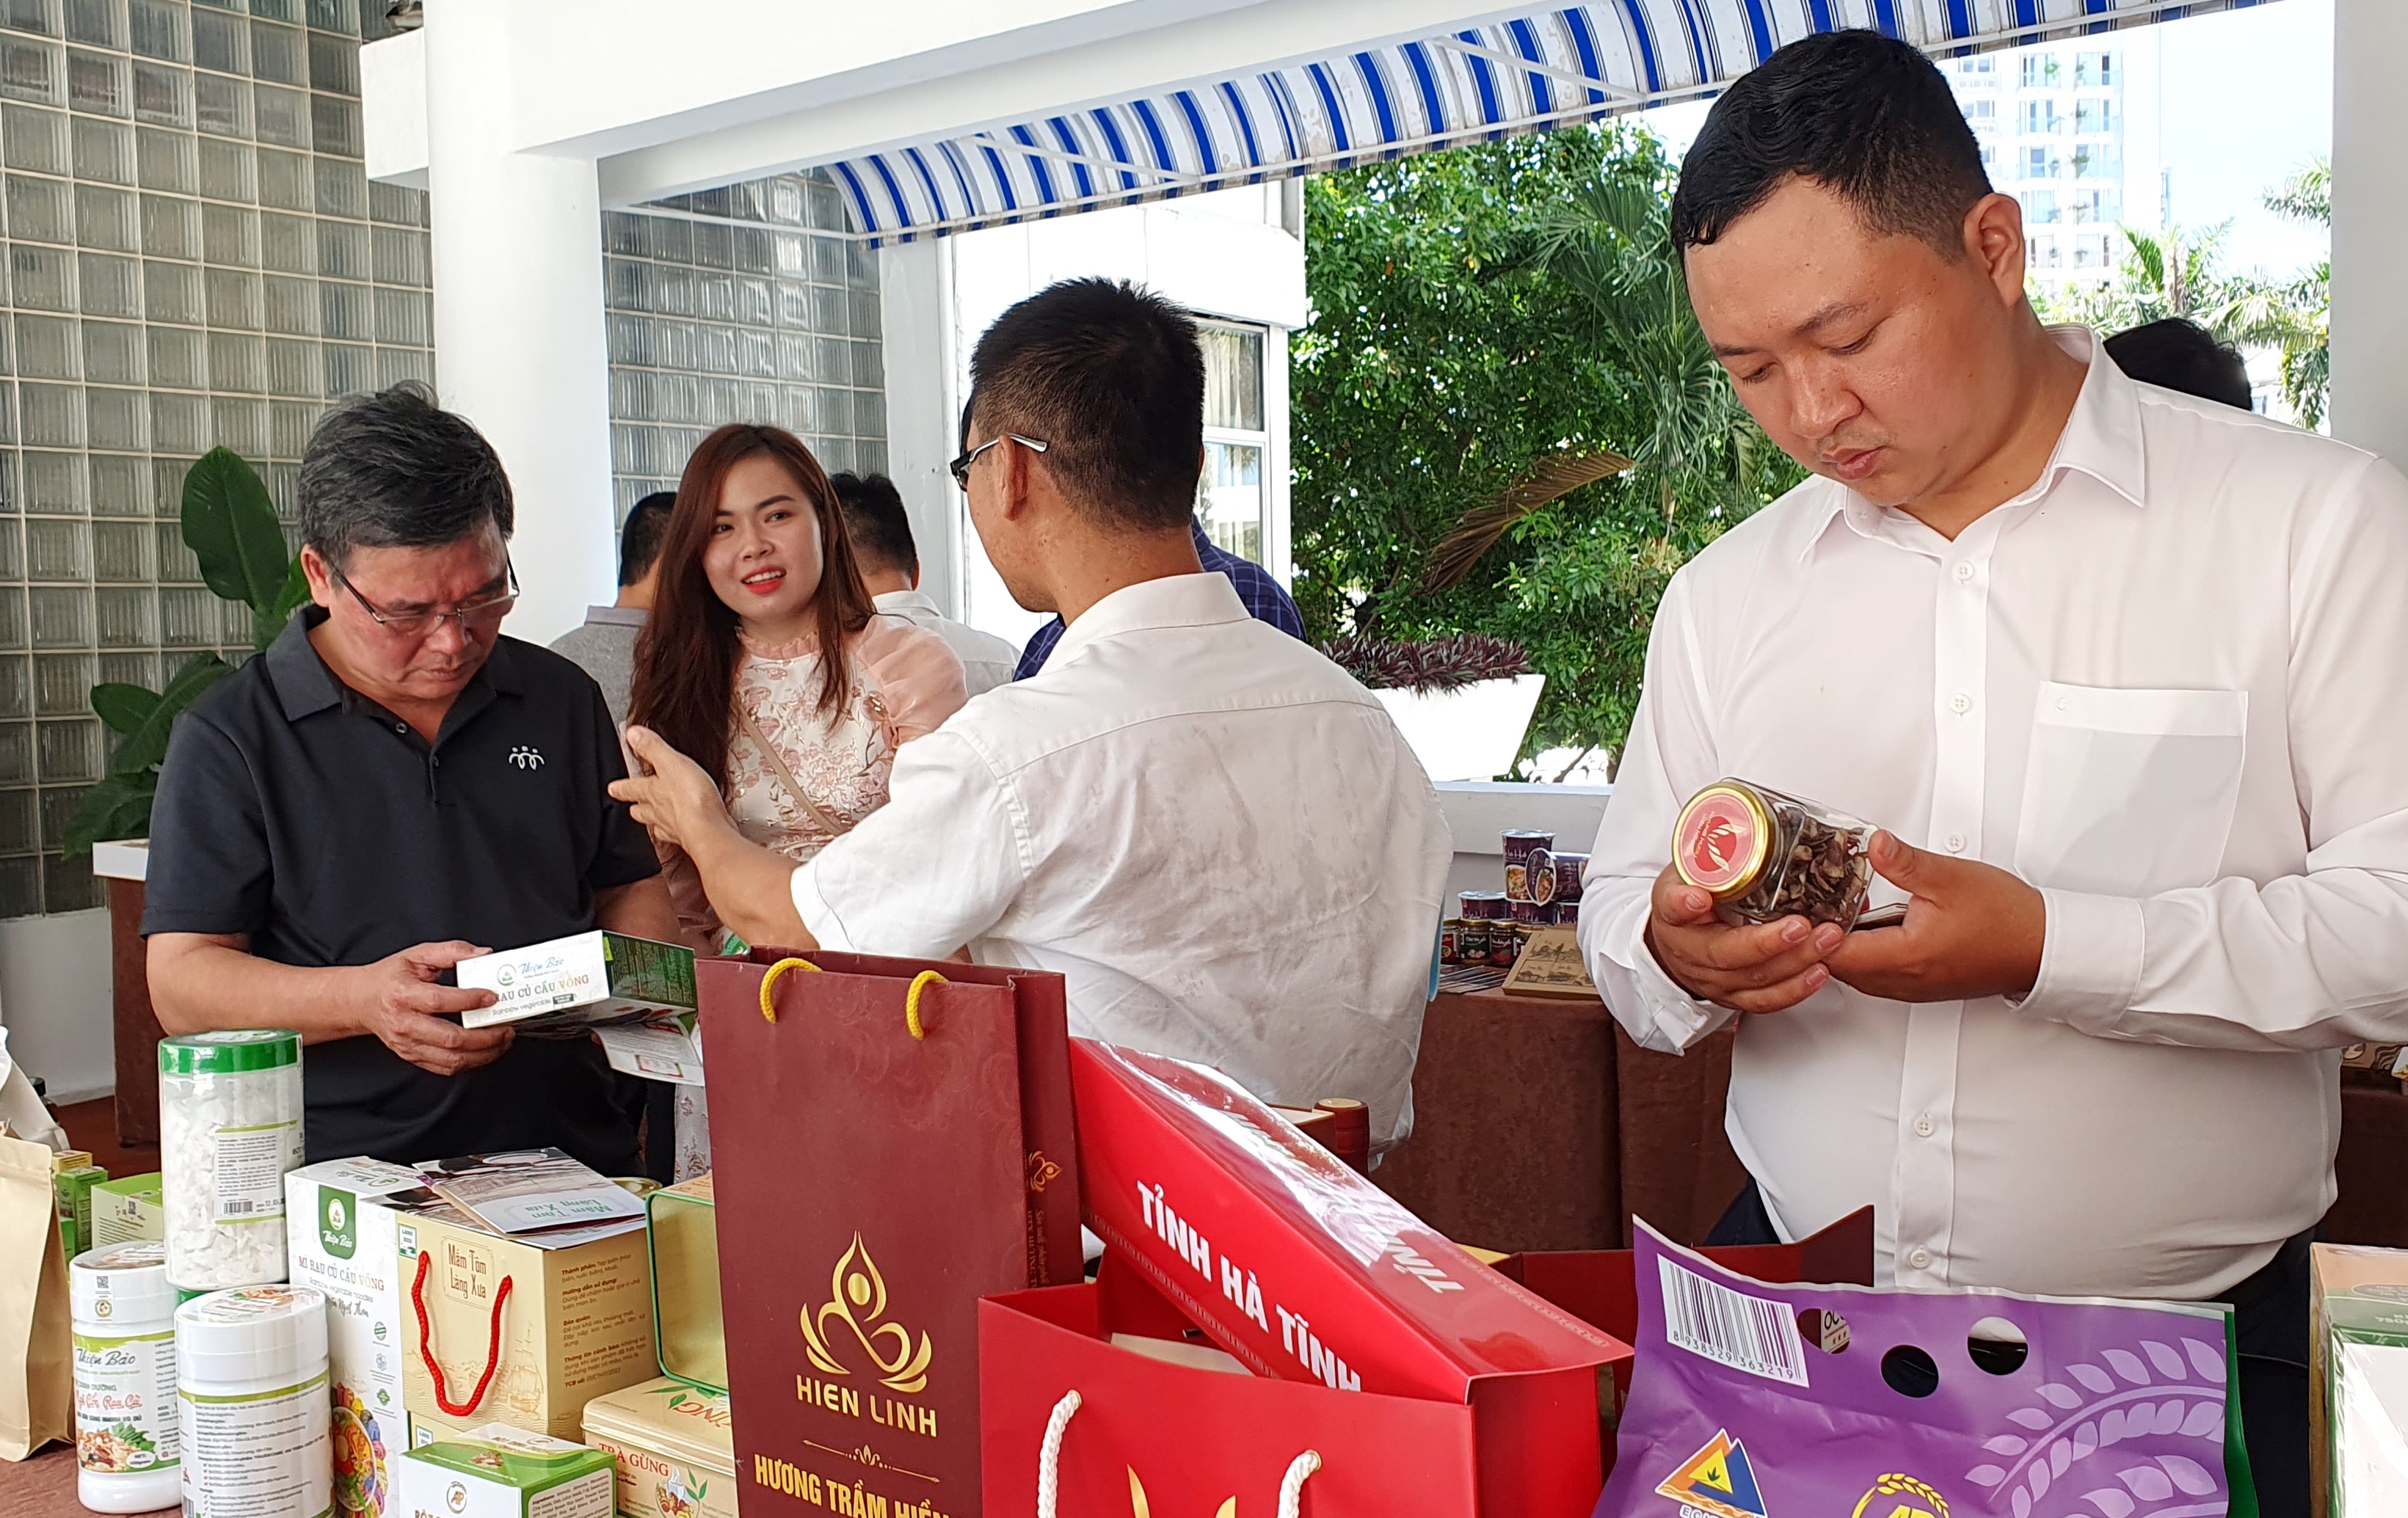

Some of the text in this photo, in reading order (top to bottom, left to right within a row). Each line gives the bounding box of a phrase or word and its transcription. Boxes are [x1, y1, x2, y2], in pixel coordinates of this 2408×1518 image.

[499, 990, 514, 1001] AU
[310, 1260, 324, 1275] RAU
[448, 1243, 487, 1275] Mắm Tôm
[450, 1267, 468, 1299] Làng
[1137, 1179, 1361, 1393] TỈNH HÀ TĨNH
[1673, 1331, 1794, 1379] 8 938529 363219
[796, 1374, 937, 1437] HIEN LINH
[629, 1453, 669, 1477] GỪNG
[754, 1453, 822, 1506] HƯƠNG
[826, 1478, 887, 1518] TRẦM
